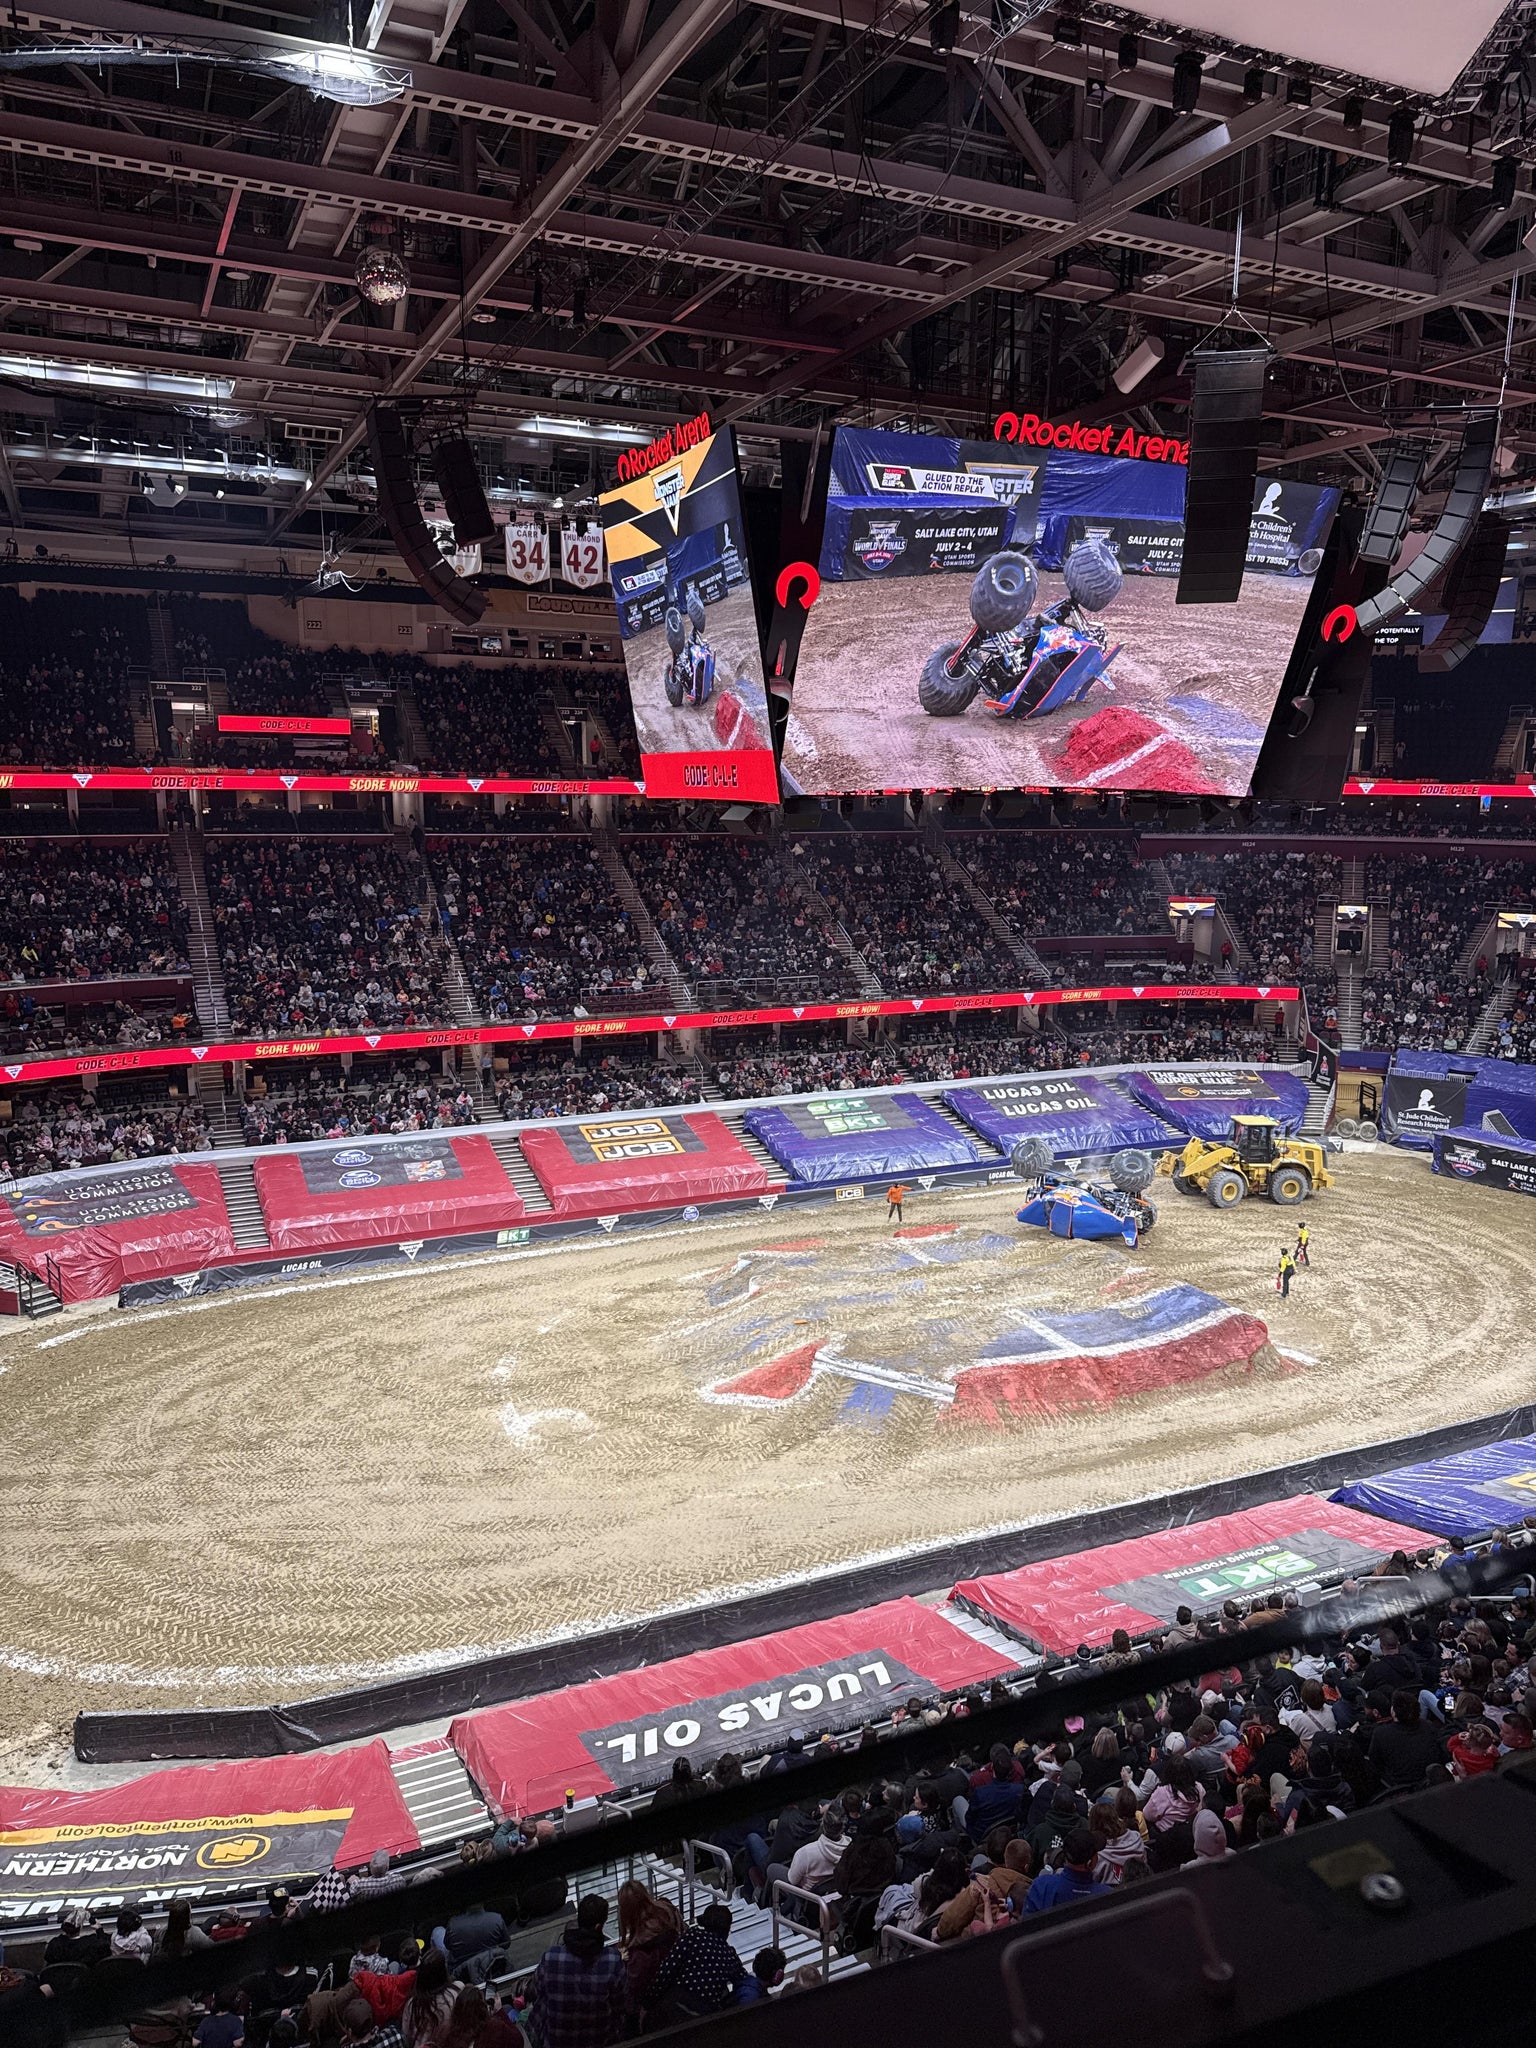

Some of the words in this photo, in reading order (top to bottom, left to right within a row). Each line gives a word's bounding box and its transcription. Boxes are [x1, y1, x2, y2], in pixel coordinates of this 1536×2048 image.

[628, 429, 674, 477] Rocket
[675, 411, 711, 453] Arena
[1019, 413, 1114, 453] Rocket
[1114, 428, 1190, 464] Arena
[925, 473, 952, 484] GLUED
[955, 475, 967, 484] TO
[968, 476, 984, 486] THE
[654, 475, 685, 501] MONSTER
[921, 481, 951, 492] ACTION
[954, 483, 985, 494] REPLAY
[915, 528, 934, 539] SALT
[934, 527, 956, 538] LAKE
[956, 527, 977, 538] CITY,
[977, 526, 999, 537] UTAH
[1257, 520, 1293, 533] Children's
[516, 529, 538, 538] CARR
[563, 533, 601, 544] THURMOND
[1259, 530, 1290, 543] Hospital
[854, 541, 878, 551] WORLD
[883, 541, 905, 551] FINALS
[935, 542, 955, 552] JULY
[954, 542, 961, 552] 2
[966, 541, 973, 551] 4
[1127, 535, 1148, 545] SALT
[1148, 536, 1169, 546] LAKE
[512, 540, 544, 571] 34
[566, 544, 599, 575] 42
[1147, 549, 1166, 559] JULY
[1166, 550, 1173, 559] 2
[1257, 555, 1265, 563] TO
[260, 720, 285, 730] CODE:
[286, 721, 312, 731] C-L-E
[151, 776, 188, 788] CODE:
[190, 776, 223, 788] C-L-E
[683, 765, 710, 786] CODE:
[712, 764, 738, 787] C-L-E
[349, 778, 386, 791] SCORE
[388, 780, 419, 791] NOW!
[531, 782, 560, 792] CODE:
[562, 782, 589, 793] C-L-E
[1419, 785, 1448, 795] CODE:
[1450, 786, 1480, 795] C-L-E
[1061, 991, 1082, 1000] SCORE
[1083, 990, 1102, 1000] NOW!
[1176, 988, 1197, 997] CODE:
[1198, 988, 1221, 998] C-L-E
[953, 998, 974, 1008] CODE:
[974, 997, 993, 1006] C-L-E
[836, 1005, 859, 1016] SCORE
[860, 1005, 881, 1015] NOW!
[712, 1013, 734, 1024] CODE:
[735, 1012, 758, 1023] C-L-E
[574, 1023, 603, 1034] SCORE
[603, 1022, 627, 1033] NOW!
[425, 1033, 452, 1044] CODE:
[454, 1031, 480, 1042] C-L-E
[255, 1044, 290, 1056] SCORE
[291, 1042, 320, 1054] NOW!
[75, 1059, 108, 1072] CODE:
[109, 1055, 140, 1068] C-L-E
[1150, 1071, 1176, 1079] THE
[1156, 1077, 1200, 1085] SUPER
[1202, 1077, 1236, 1085] GLUE
[983, 1085, 1042, 1100] LUCAS
[1002, 1100, 1063, 1116] LUCAS
[1397, 1118, 1424, 1127] Research
[1424, 1121, 1450, 1130] Hospital
[1406, 1112, 1420, 1120] Jude
[1420, 1114, 1450, 1124] Children's
[591, 1122, 662, 1139] JCB
[603, 1141, 677, 1159] JCB
[1491, 1158, 1509, 1168] SALT
[1509, 1162, 1528, 1172] LAKE
[988, 1171, 1006, 1180] LUCAS
[1512, 1172, 1528, 1181] JULY
[1529, 1175, 1535, 1183] 2
[64, 1182, 108, 1196] UTAH
[113, 1171, 170, 1189] SPORTS
[69, 1177, 174, 1201] COMMISSION
[838, 1189, 863, 1199] JCB
[79, 1203, 122, 1216] UTAH
[128, 1192, 186, 1209] SPORTS
[83, 1198, 190, 1224] COMMISSION
[498, 1230, 530, 1243] BKT
[281, 1261, 307, 1273] LUCAS
[308, 1259, 322, 1270] OIL
[1228, 1544, 1280, 1563] GROWING
[1163, 1560, 1226, 1580] TOGETHER
[1197, 1552, 1312, 1598] BKT
[1290, 1567, 1345, 1586] GROWING
[1230, 1584, 1291, 1604] TOGETHE
[718, 1661, 892, 1732] LUCAS
[56, 1816, 254, 1838] www.northerntool.com
[145, 1844, 191, 1855] TOOL
[7, 1851, 187, 1876] NORTHERN
